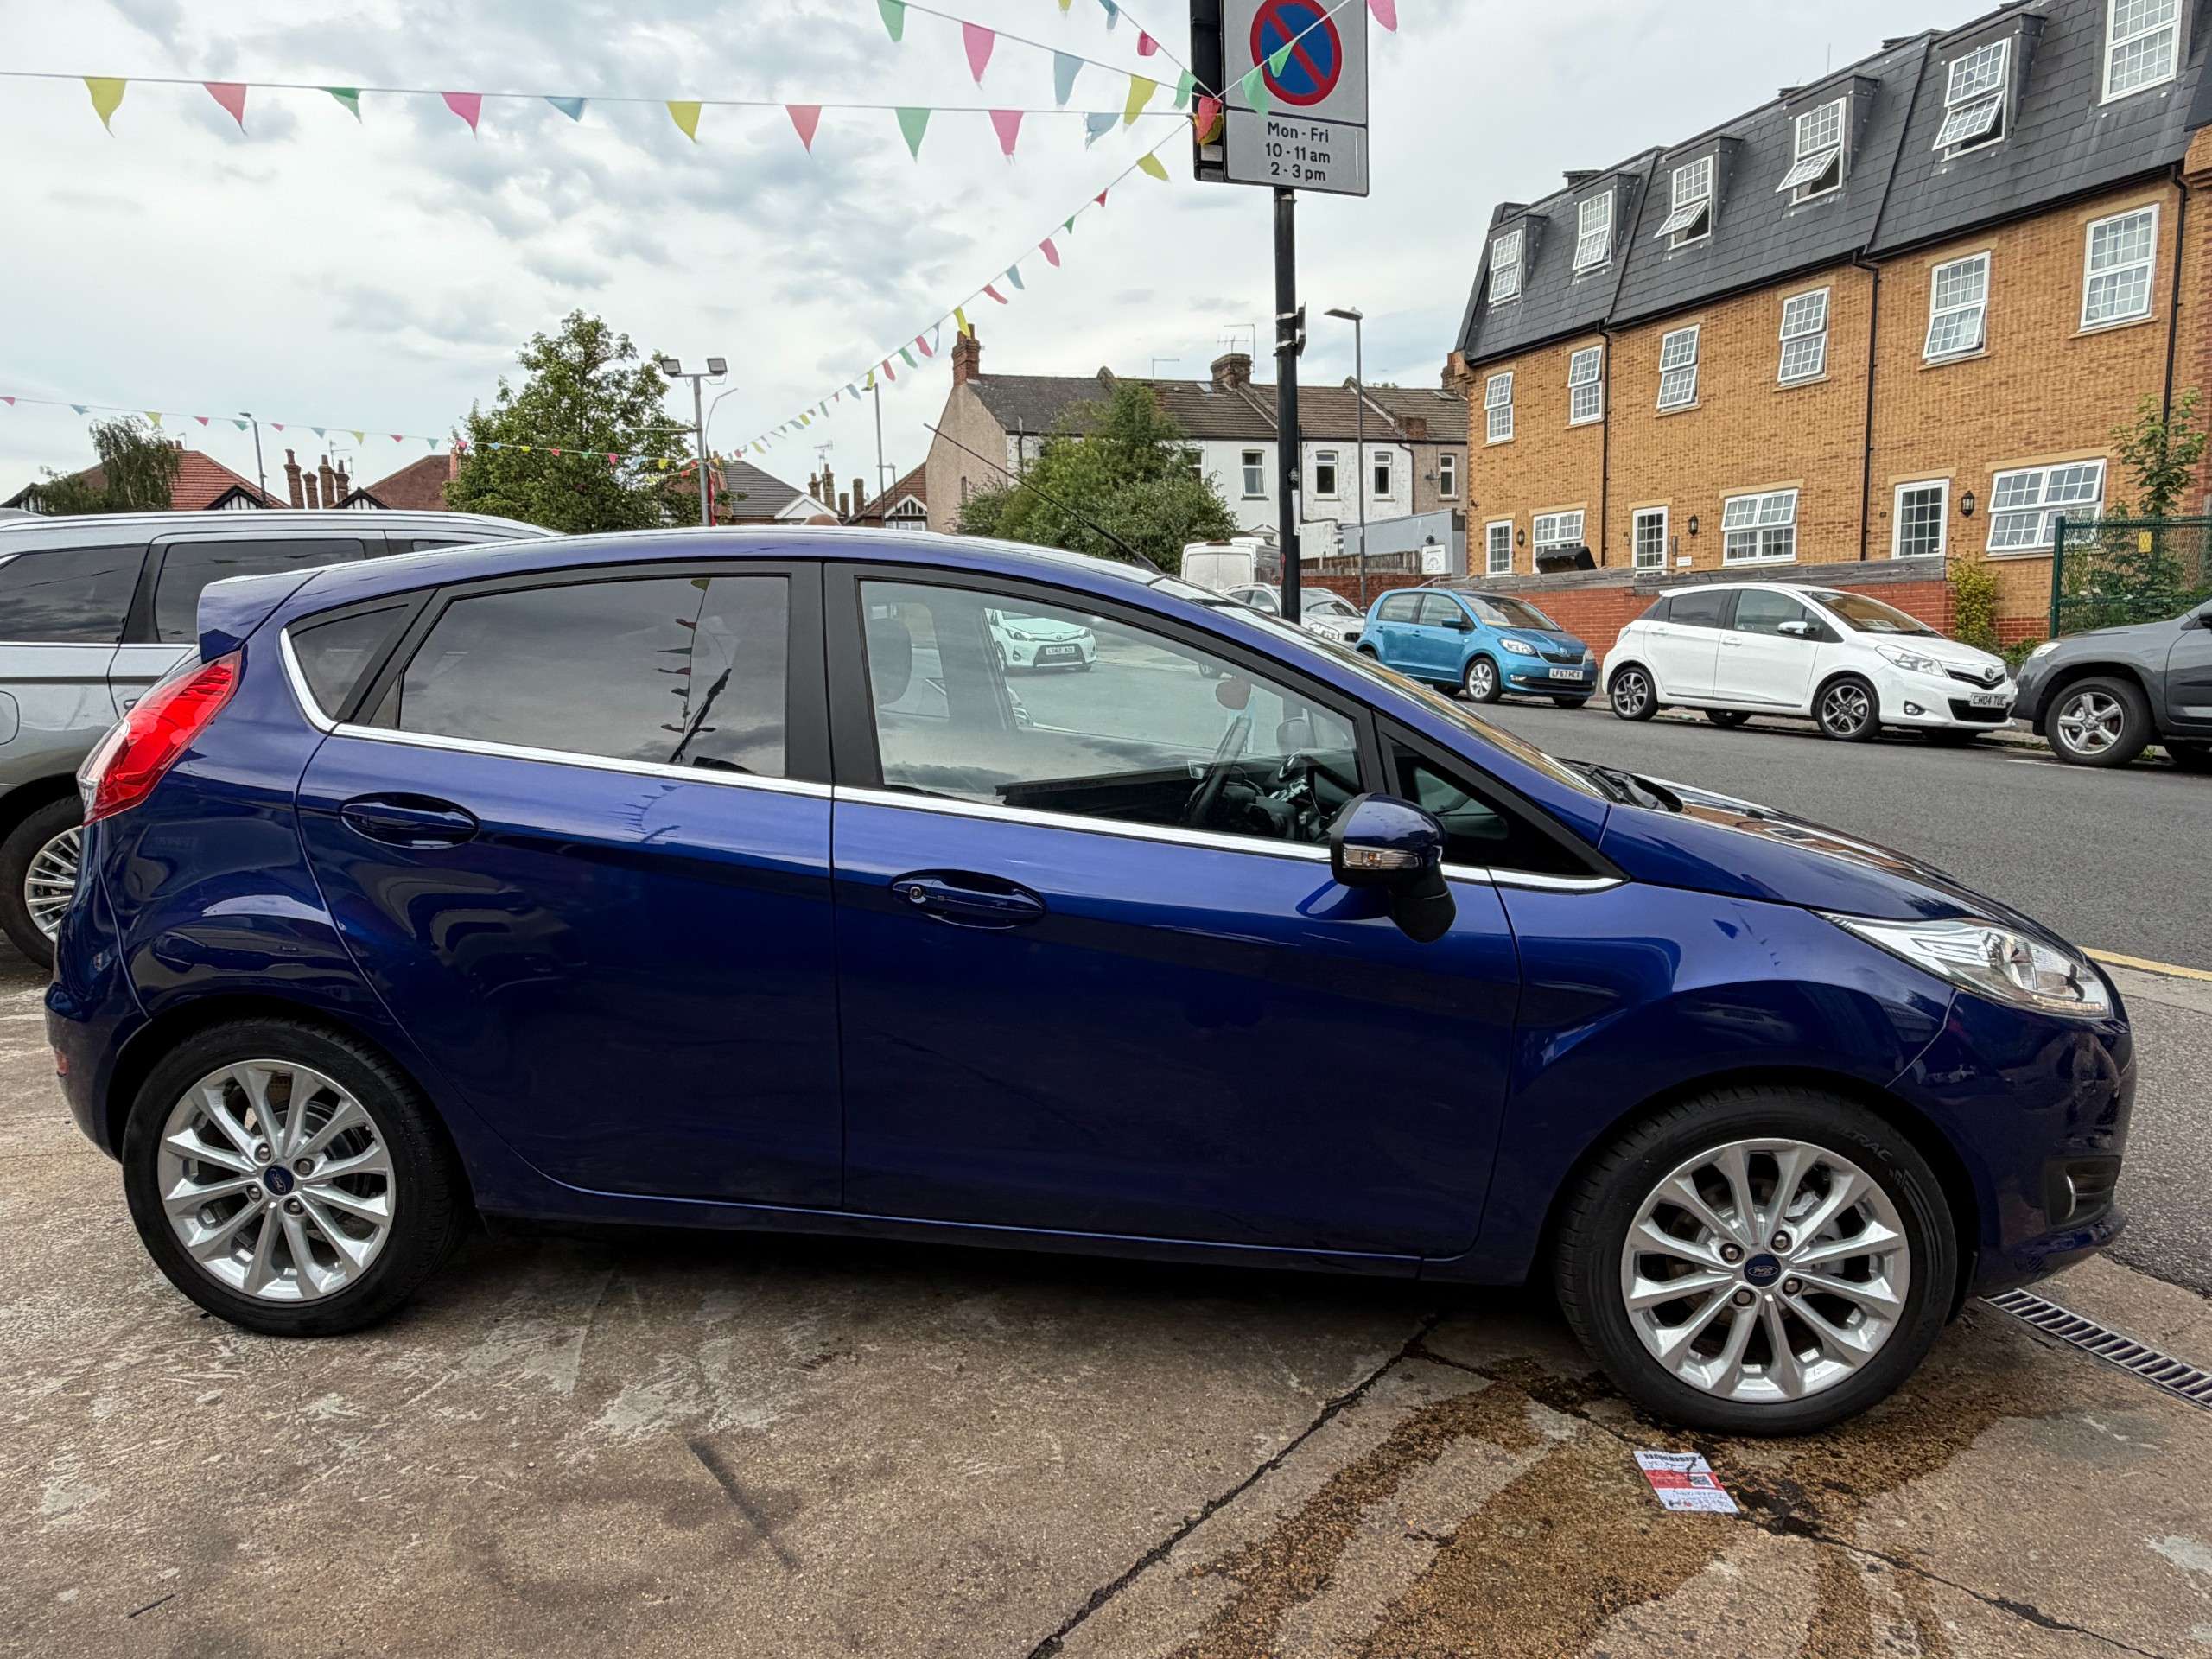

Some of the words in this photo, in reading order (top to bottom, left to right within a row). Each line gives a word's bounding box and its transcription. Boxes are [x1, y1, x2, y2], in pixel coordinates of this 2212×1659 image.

[1268, 121, 1298, 138] Mon
[1311, 127, 1329, 143] Fri
[1265, 142, 1283, 157] 10
[1310, 150, 1331, 163] am
[1270, 161, 1280, 175] 2
[1292, 163, 1301, 179] 3
[1305, 168, 1326, 181] pm
